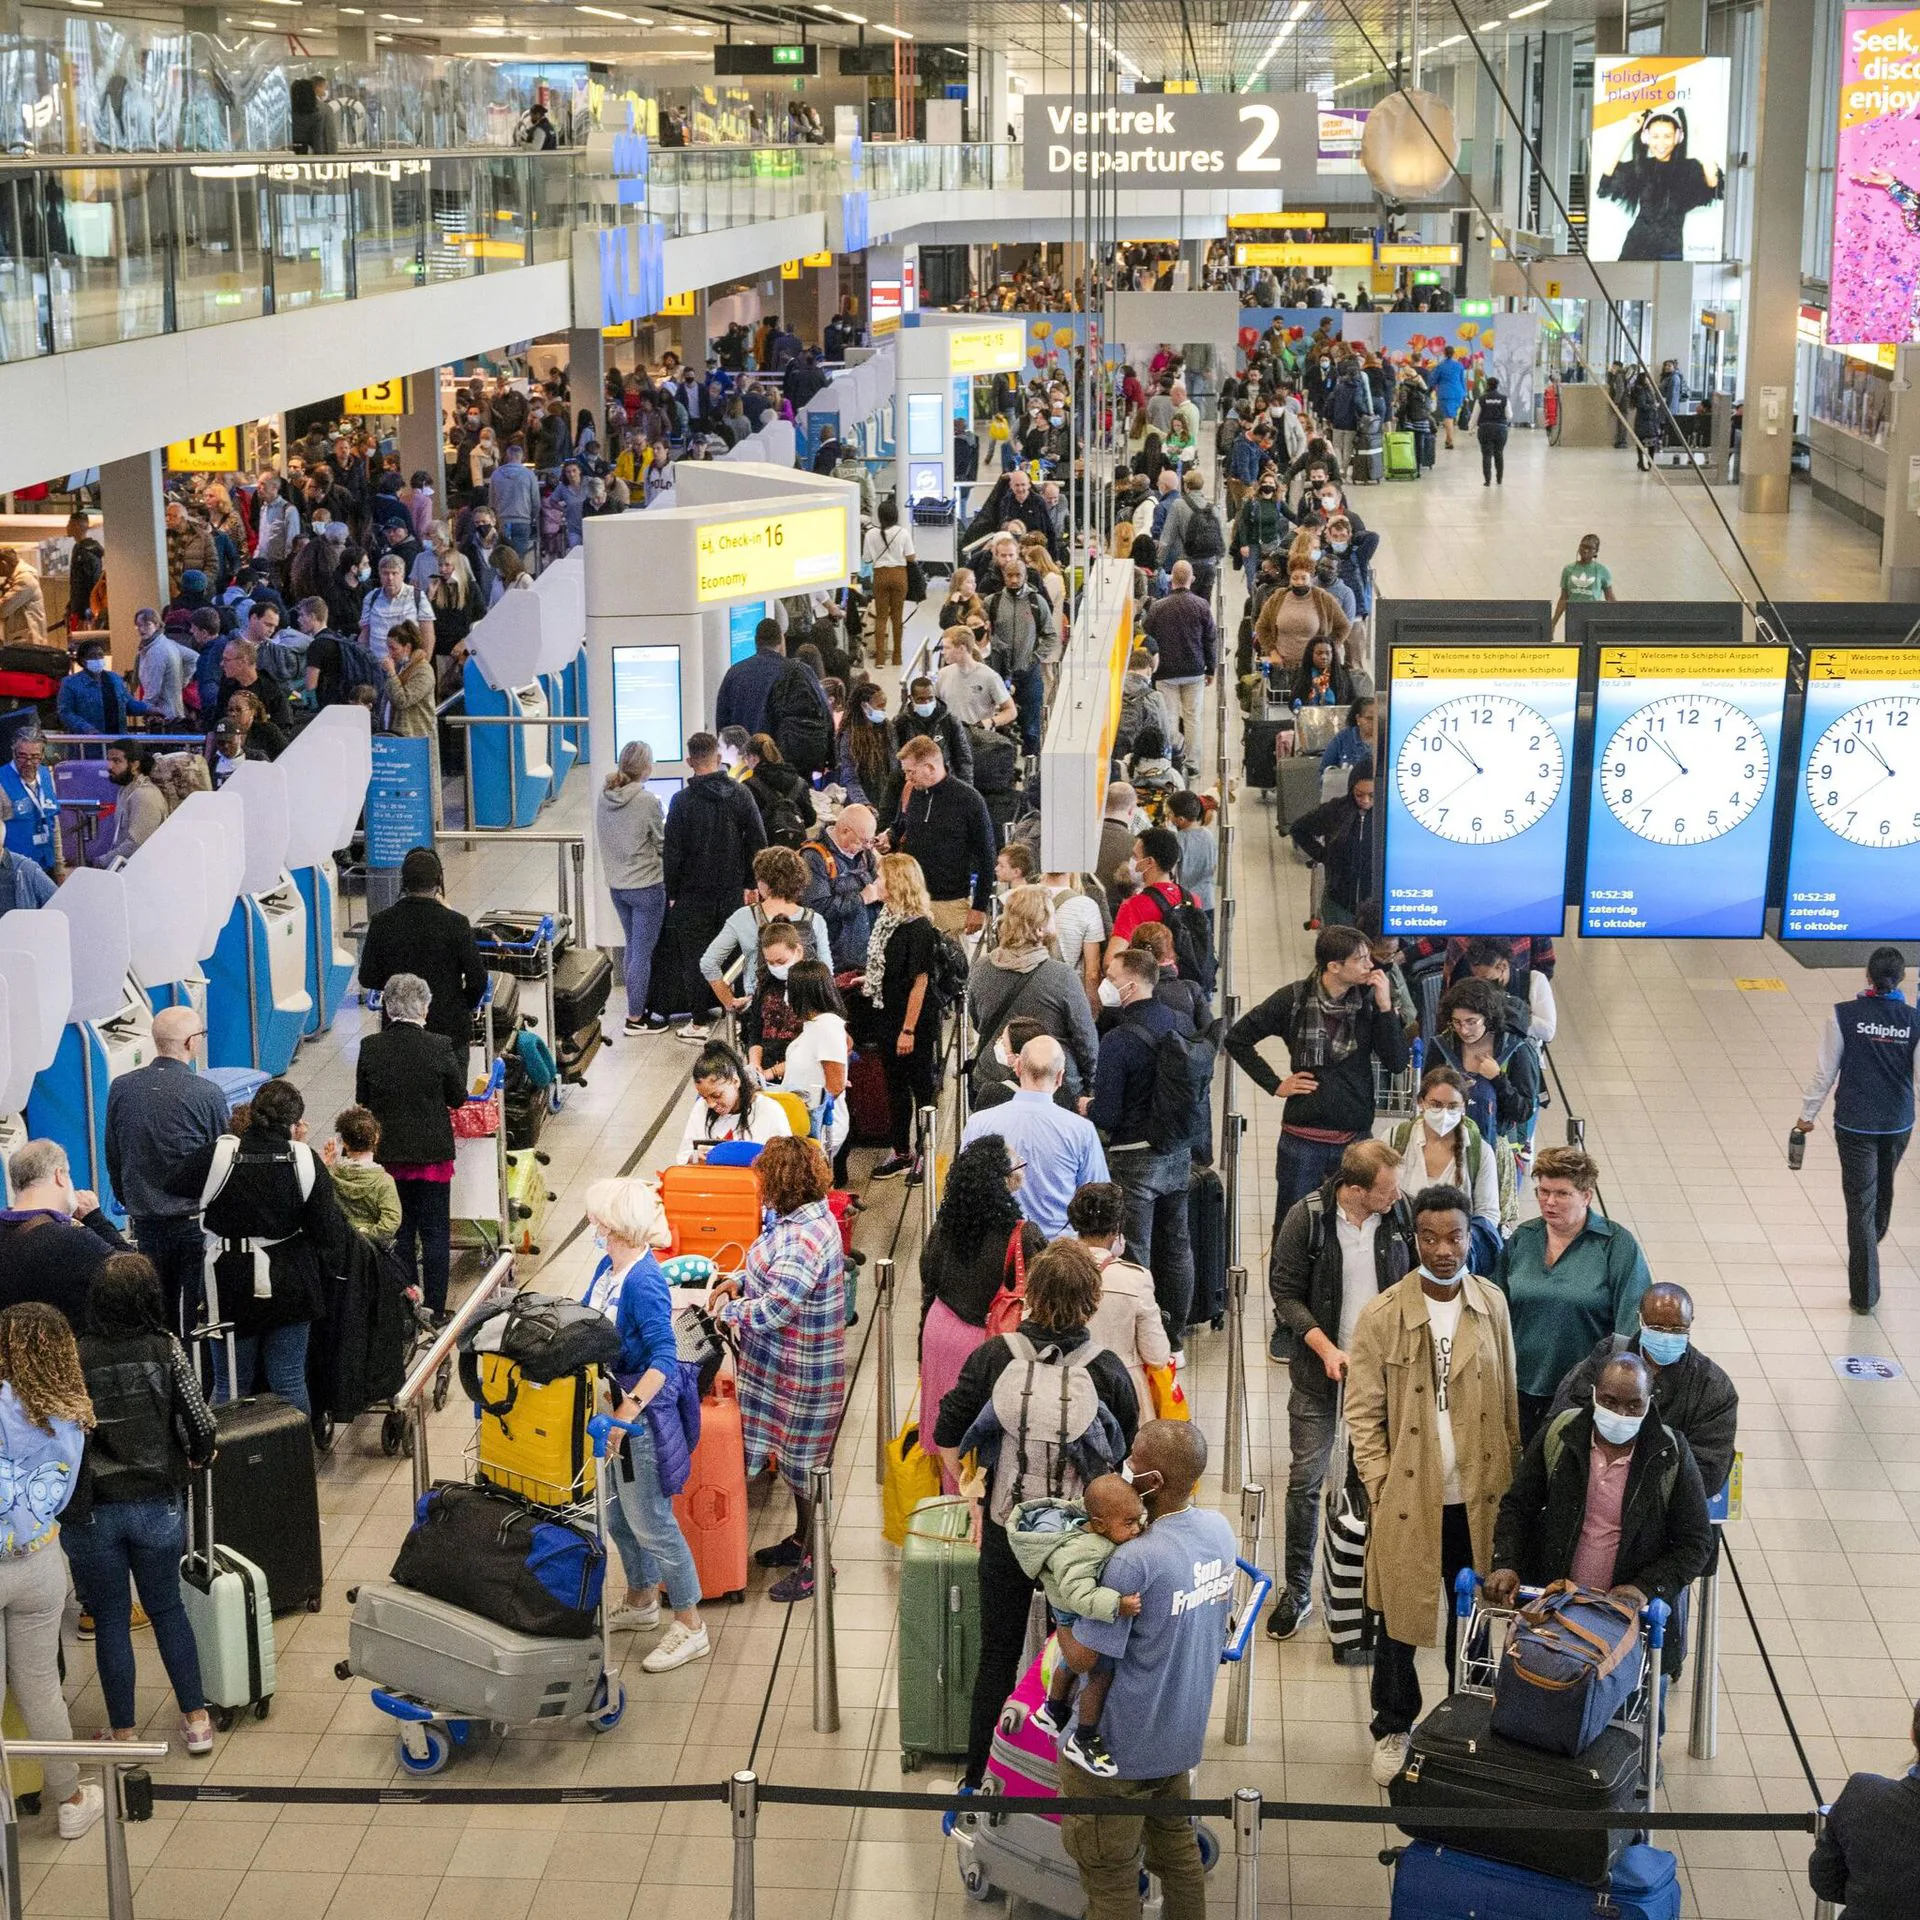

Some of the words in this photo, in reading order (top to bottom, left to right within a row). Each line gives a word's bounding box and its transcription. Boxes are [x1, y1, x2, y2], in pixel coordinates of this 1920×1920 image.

[1852, 28, 1920, 56] Seek,
[1601, 70, 1659, 85] Holiday
[1608, 87, 1662, 102] playlist
[1667, 88, 1691, 100] on!
[1849, 83, 1920, 120] enjoy
[1047, 103, 1176, 134] Vertrek
[1236, 104, 1282, 172] 2
[1048, 145, 1225, 179] Departures
[600, 224, 664, 327] KLM
[1550, 283, 1557, 295] F
[718, 533, 762, 550] Check-in
[765, 524, 784, 548] 16
[701, 572, 747, 590] Economy
[1432, 652, 1469, 660] Welcome
[1483, 653, 1518, 661] Schiphol
[1520, 653, 1550, 661] Airport
[1692, 652, 1727, 661] Schiphol
[1729, 652, 1760, 661] Airport
[1530, 666, 1565, 675] Schiphol
[1738, 666, 1774, 675] Schiphol
[1471, 709, 1493, 724] 12
[1677, 709, 1700, 724] 12
[1886, 711, 1909, 726] 12
[1440, 717, 1459, 732] 11
[1508, 718, 1515, 732] 1
[1646, 717, 1665, 732] 11
[1714, 718, 1722, 733] 1
[1854, 719, 1873, 734] 11
[1420, 737, 1443, 751] 10
[1529, 736, 1540, 751] 2
[1625, 737, 1648, 752] 10
[1735, 736, 1747, 751] 2
[1833, 738, 1855, 754] 10
[1411, 763, 1421, 777] 9
[1538, 764, 1550, 778] 3
[1614, 763, 1626, 777] 9
[1744, 764, 1755, 779] 3
[1821, 765, 1832, 780] 9
[1418, 788, 1429, 803] 8
[1525, 791, 1536, 805] 4
[1622, 789, 1633, 804] 8
[1729, 792, 1740, 806] 4
[1827, 791, 1838, 806] 8
[1438, 808, 1449, 823] 7
[1504, 809, 1515, 824] 5
[1641, 809, 1653, 824] 7
[1707, 810, 1718, 825] 5
[1846, 811, 1858, 826] 7
[1471, 817, 1482, 832] 6
[1674, 818, 1685, 832] 6
[1879, 820, 1891, 835] 6
[1391, 889, 1434, 898] 10:52:38
[1590, 890, 1634, 899] 10:52:38
[1792, 893, 1836, 902] 10:52:38
[1389, 904, 1438, 914] zaterdag
[1588, 905, 1638, 916] zaterdag
[1790, 907, 1840, 918] zaterdag
[1390, 918, 1402, 926] 16
[1404, 917, 1448, 926] oktober
[1588, 920, 1600, 928] 16
[1603, 919, 1647, 928] oktober
[1789, 922, 1802, 930] 16
[1804, 922, 1849, 931] oktober
[1856, 1022, 1911, 1039] Schiphol
[1193, 1558, 1222, 1589] San
